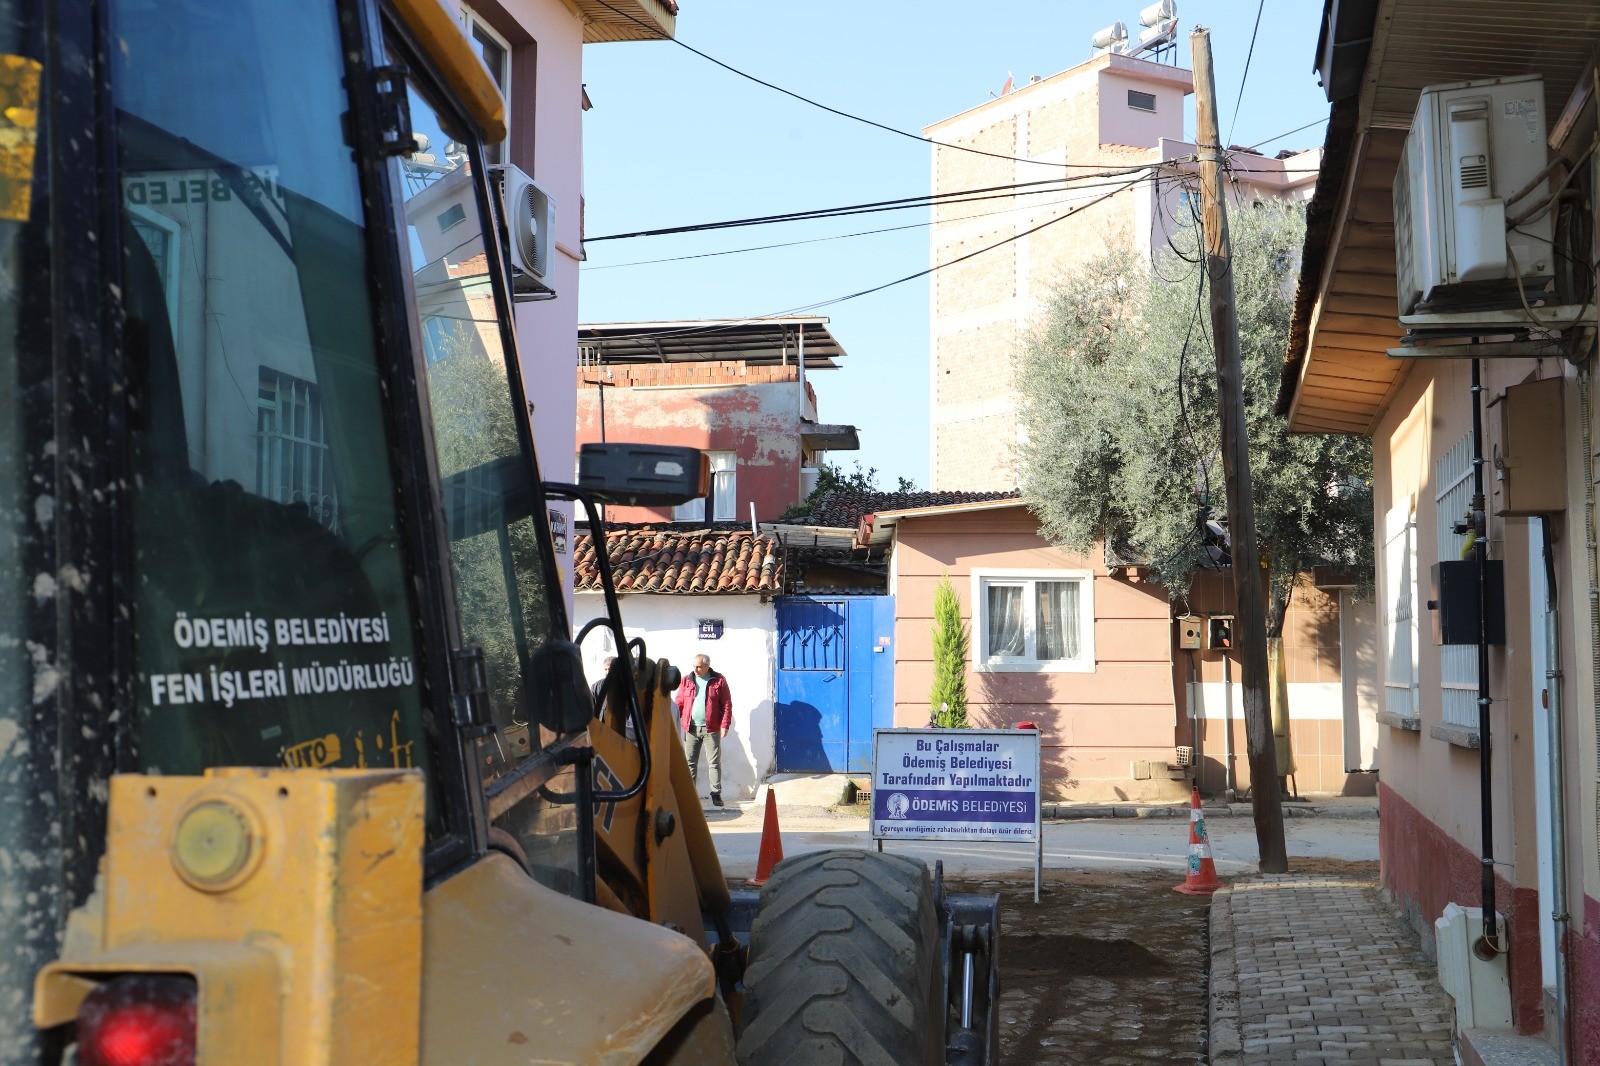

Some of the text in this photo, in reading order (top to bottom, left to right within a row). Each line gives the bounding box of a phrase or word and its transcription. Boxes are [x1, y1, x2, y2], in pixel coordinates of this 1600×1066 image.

[173, 611, 390, 654] ÖDEMİŞ BELEDİYESİ
[150, 673, 205, 706] FEN
[209, 662, 287, 708] İŞLERİ
[916, 739, 1000, 754] Bu Çalışmalar
[902, 753, 1012, 771] Ödemiş Belediyesi
[882, 772, 1033, 788] Tarafından Yapılmaktadır
